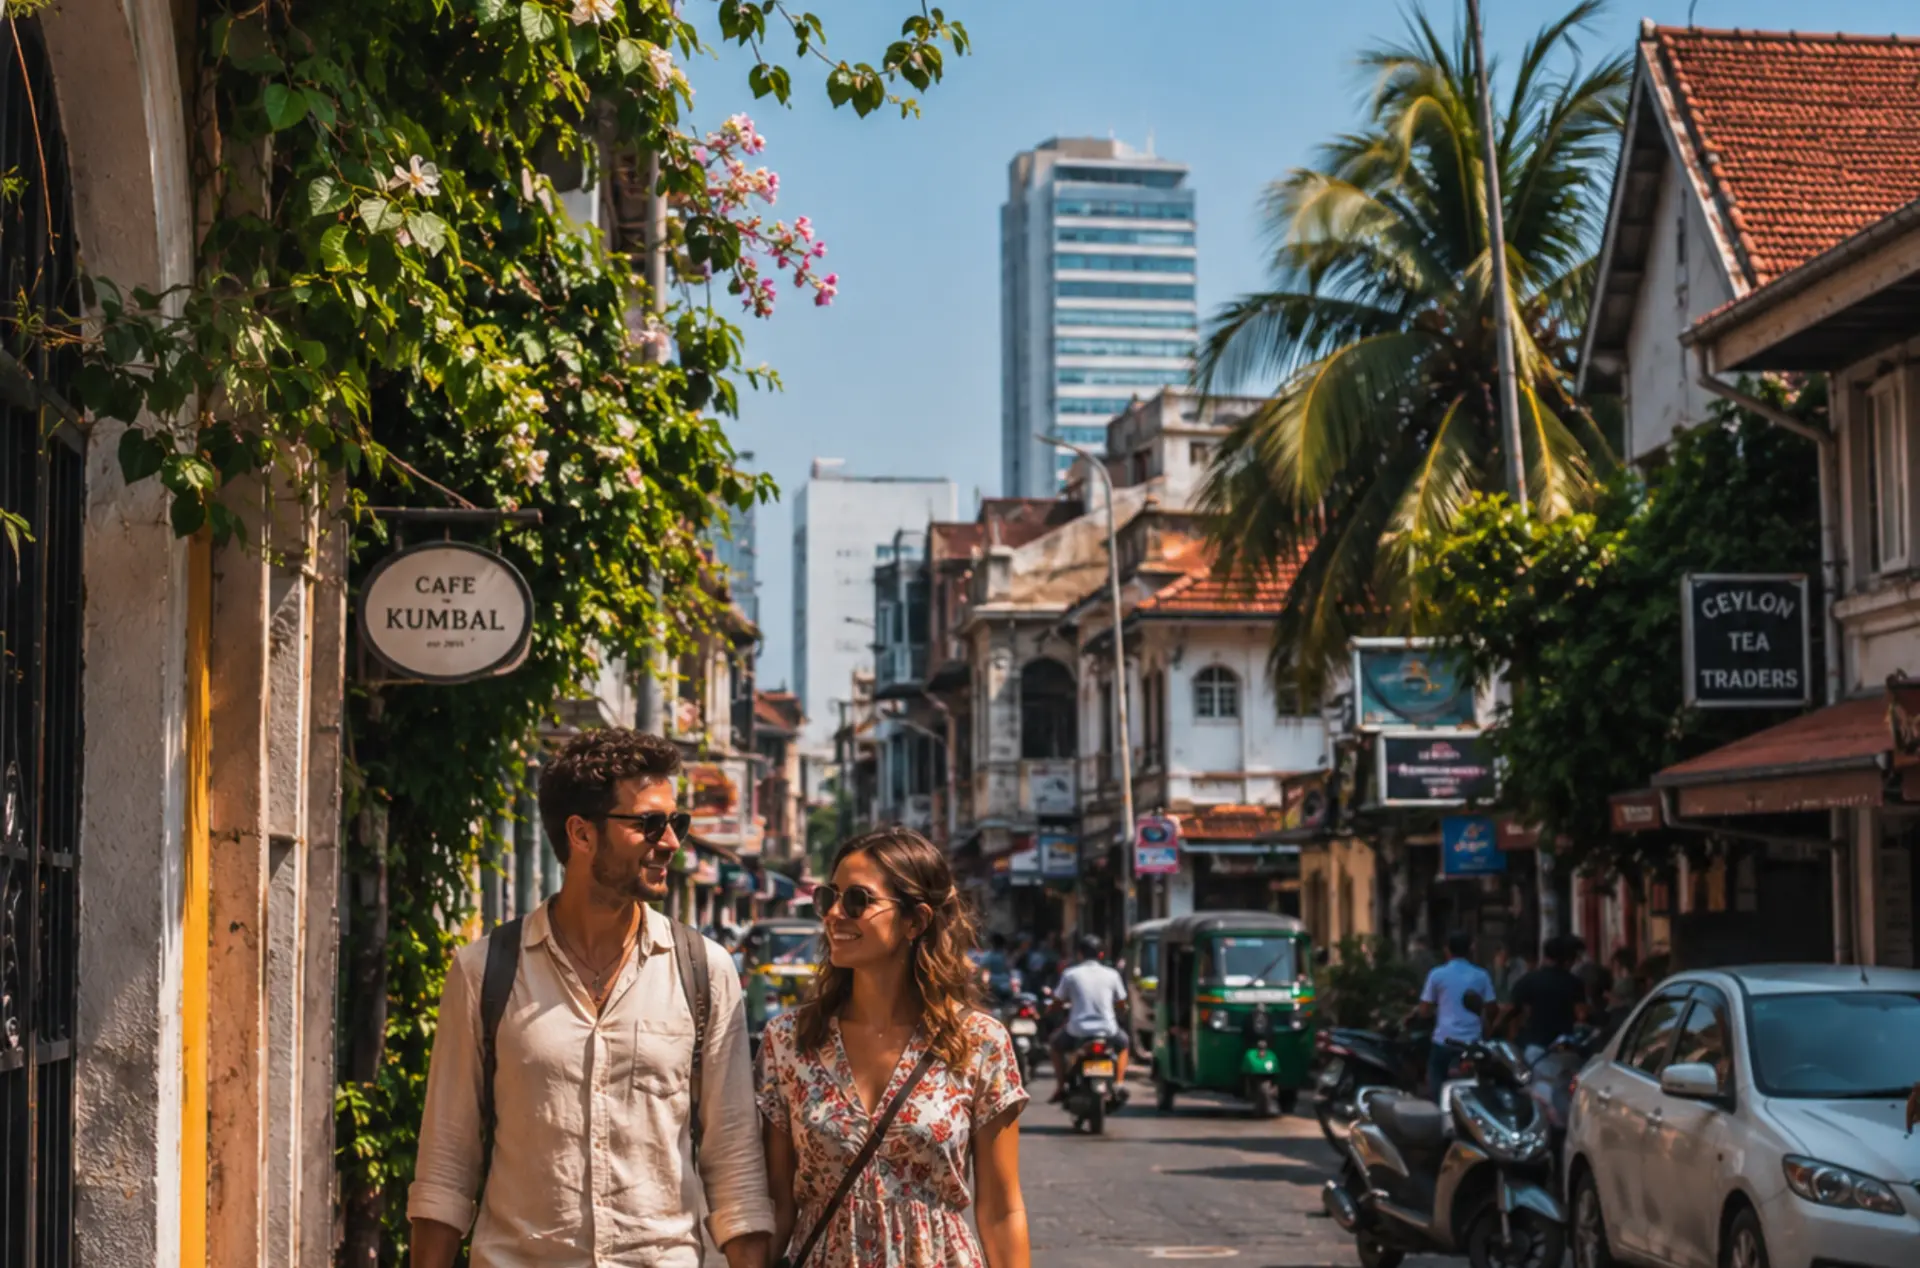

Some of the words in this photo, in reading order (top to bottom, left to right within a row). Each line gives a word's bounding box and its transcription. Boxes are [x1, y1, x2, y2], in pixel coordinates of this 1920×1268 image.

[415, 575, 476, 595] CAFE
[1701, 590, 1795, 620] CEYLON
[386, 607, 506, 631] KUMBAL
[1727, 631, 1771, 652] TEA
[1701, 668, 1798, 689] TRADERS
